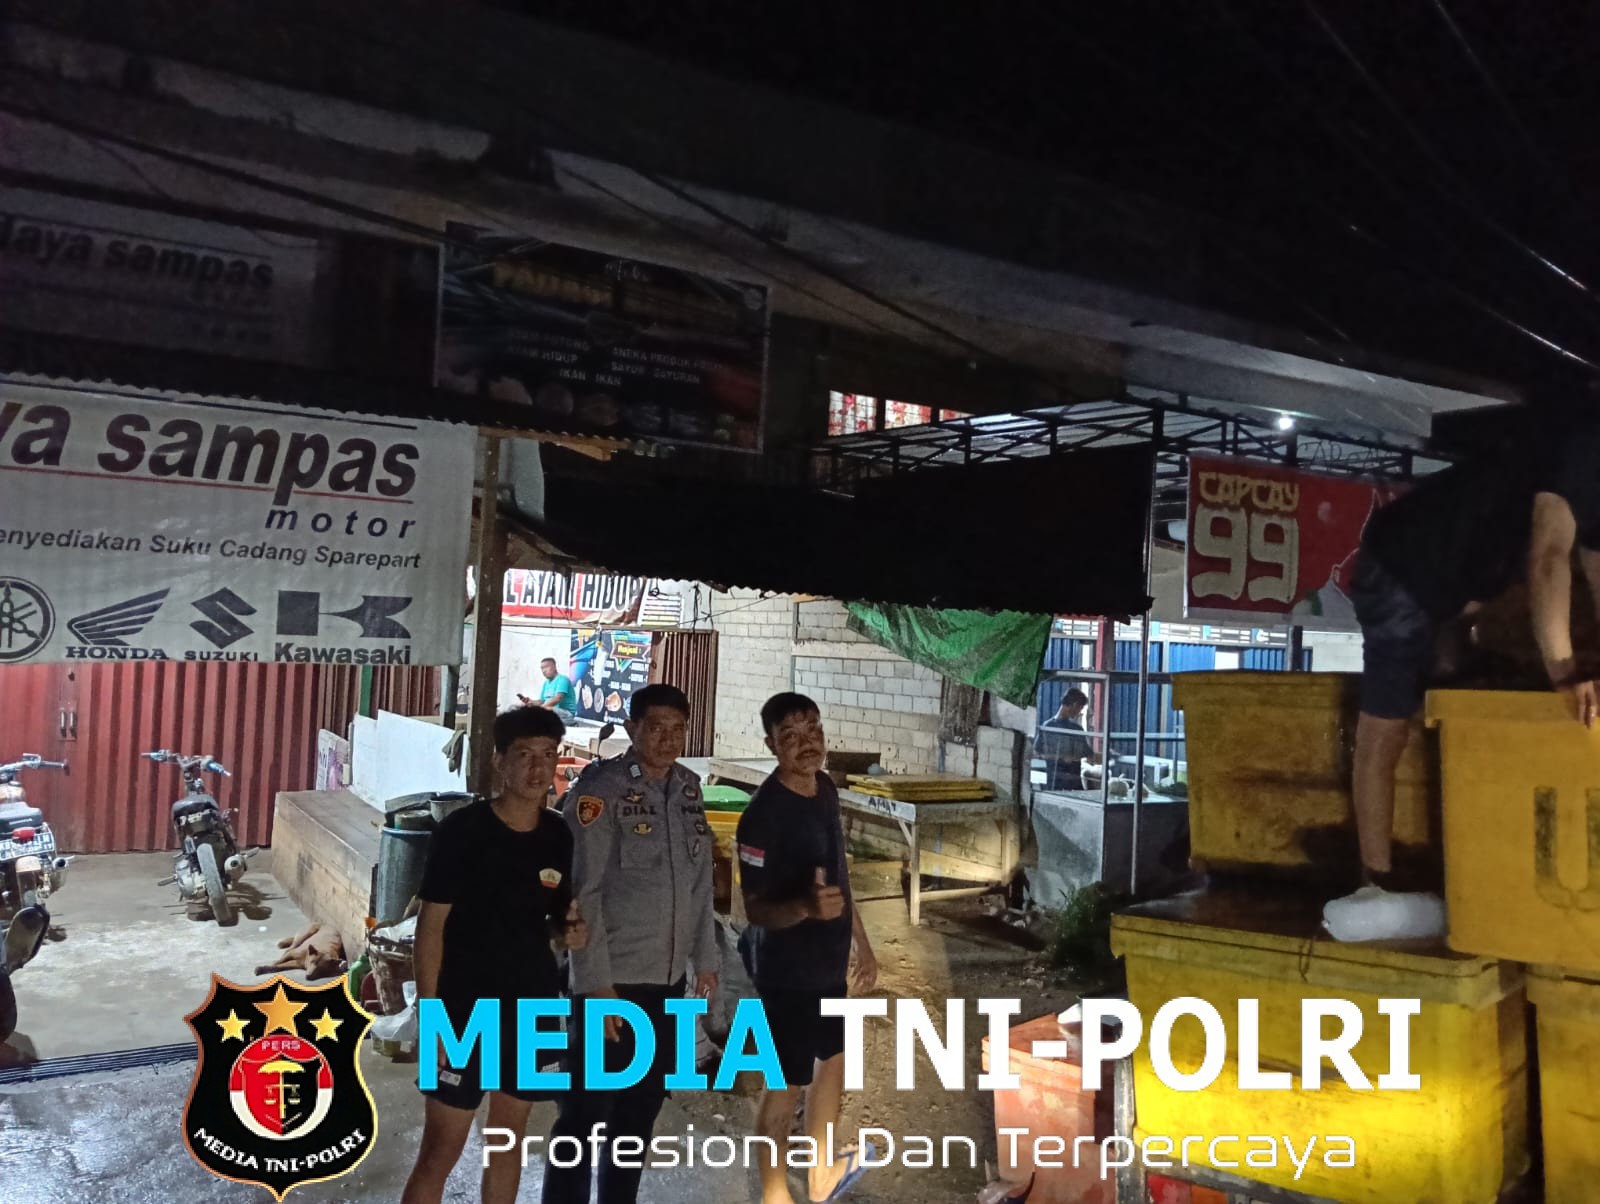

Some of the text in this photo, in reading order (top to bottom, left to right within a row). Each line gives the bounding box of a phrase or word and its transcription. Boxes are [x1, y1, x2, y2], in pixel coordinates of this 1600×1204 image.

[104, 235, 274, 300] sampas
[559, 368, 623, 387] IKAN IKAN
[97, 413, 420, 506] sampas
[265, 508, 416, 539] motor
[0, 529, 422, 571] enyediakan Suku Cadang Sparepart
[1191, 502, 1300, 605] 99
[65, 645, 258, 662] HONDA SUZUKI
[274, 641, 412, 665] Kawasaki
